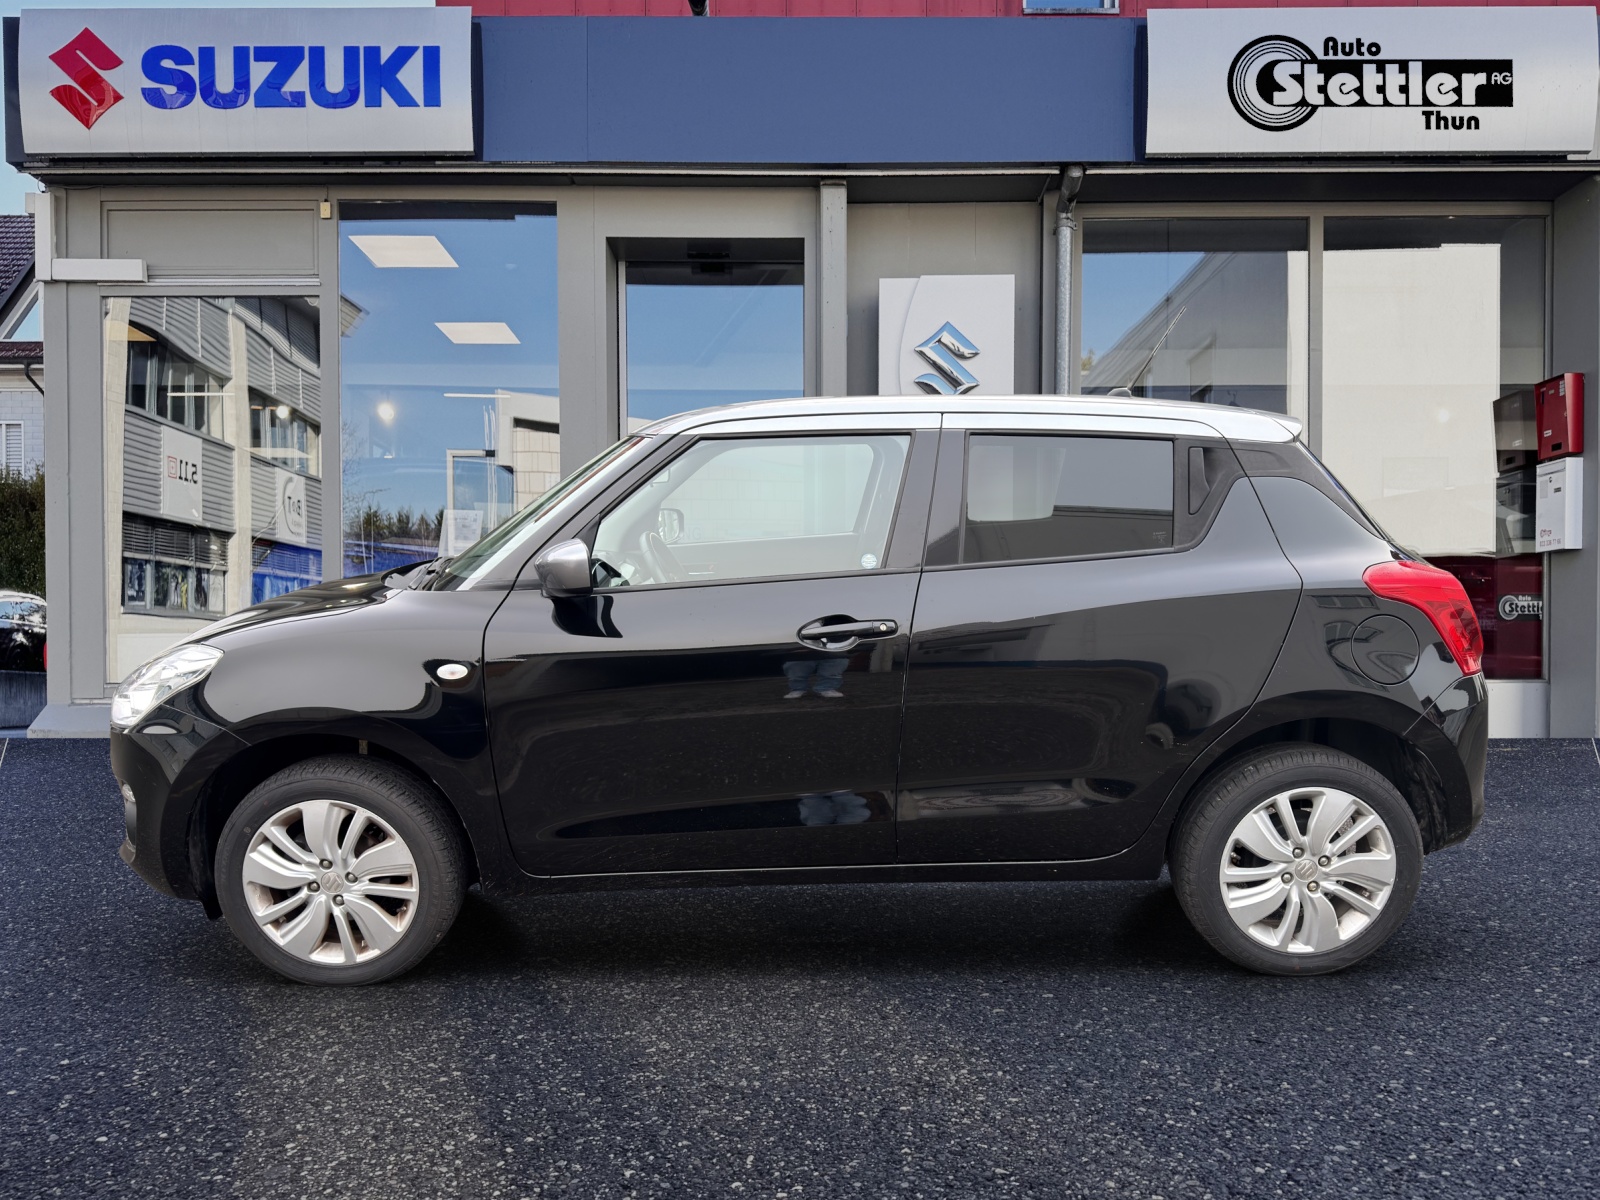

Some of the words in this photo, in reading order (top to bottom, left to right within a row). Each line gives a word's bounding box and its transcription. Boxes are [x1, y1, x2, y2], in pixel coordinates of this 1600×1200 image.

[1323, 36, 1381, 57] Auto
[140, 45, 441, 109] SUZUKI
[1273, 61, 1487, 106] Stettler
[1491, 72, 1513, 85] AG
[1422, 110, 1480, 131] Thun
